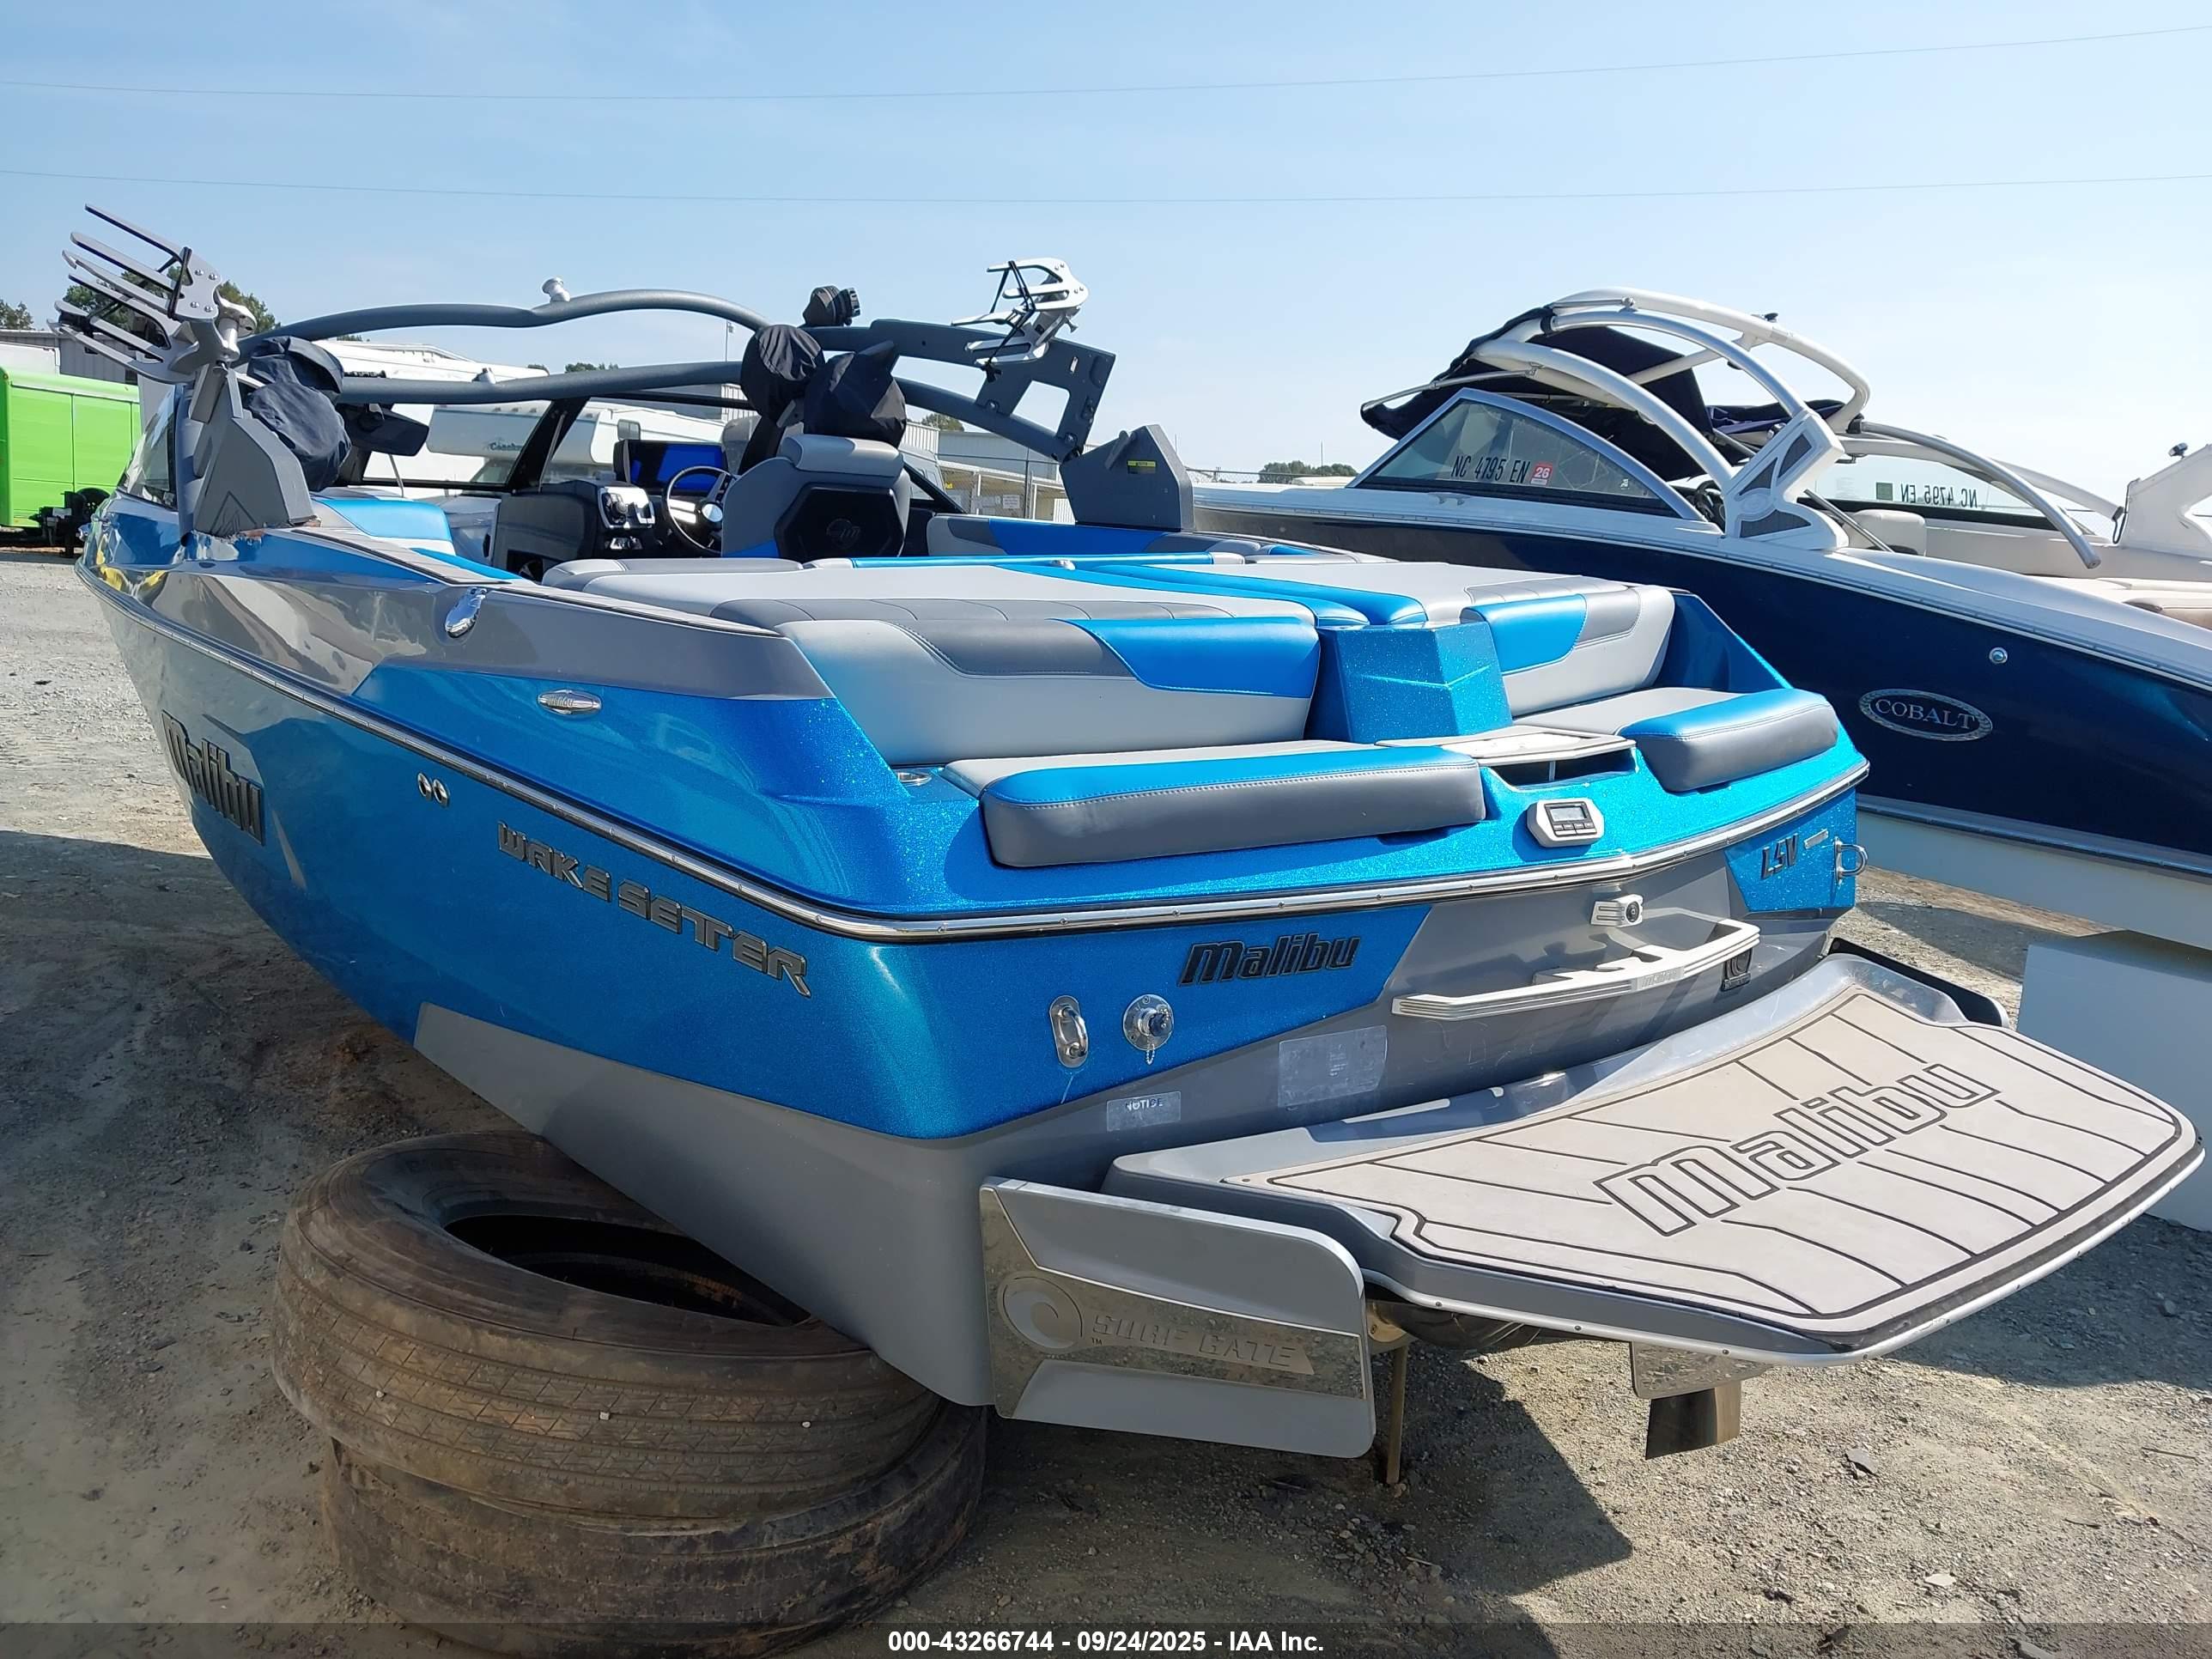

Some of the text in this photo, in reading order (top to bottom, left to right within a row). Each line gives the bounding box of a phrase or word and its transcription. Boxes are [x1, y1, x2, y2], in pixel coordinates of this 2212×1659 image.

[1451, 455, 1531, 483] NC 4795 EN
[1534, 466, 1551, 479] 26
[1875, 698, 1976, 730] COBALT
[1760, 832, 1799, 881] LSV
[1125, 1097, 1164, 1112] NOTICE
[1198, 1334, 1296, 1367] GATE
